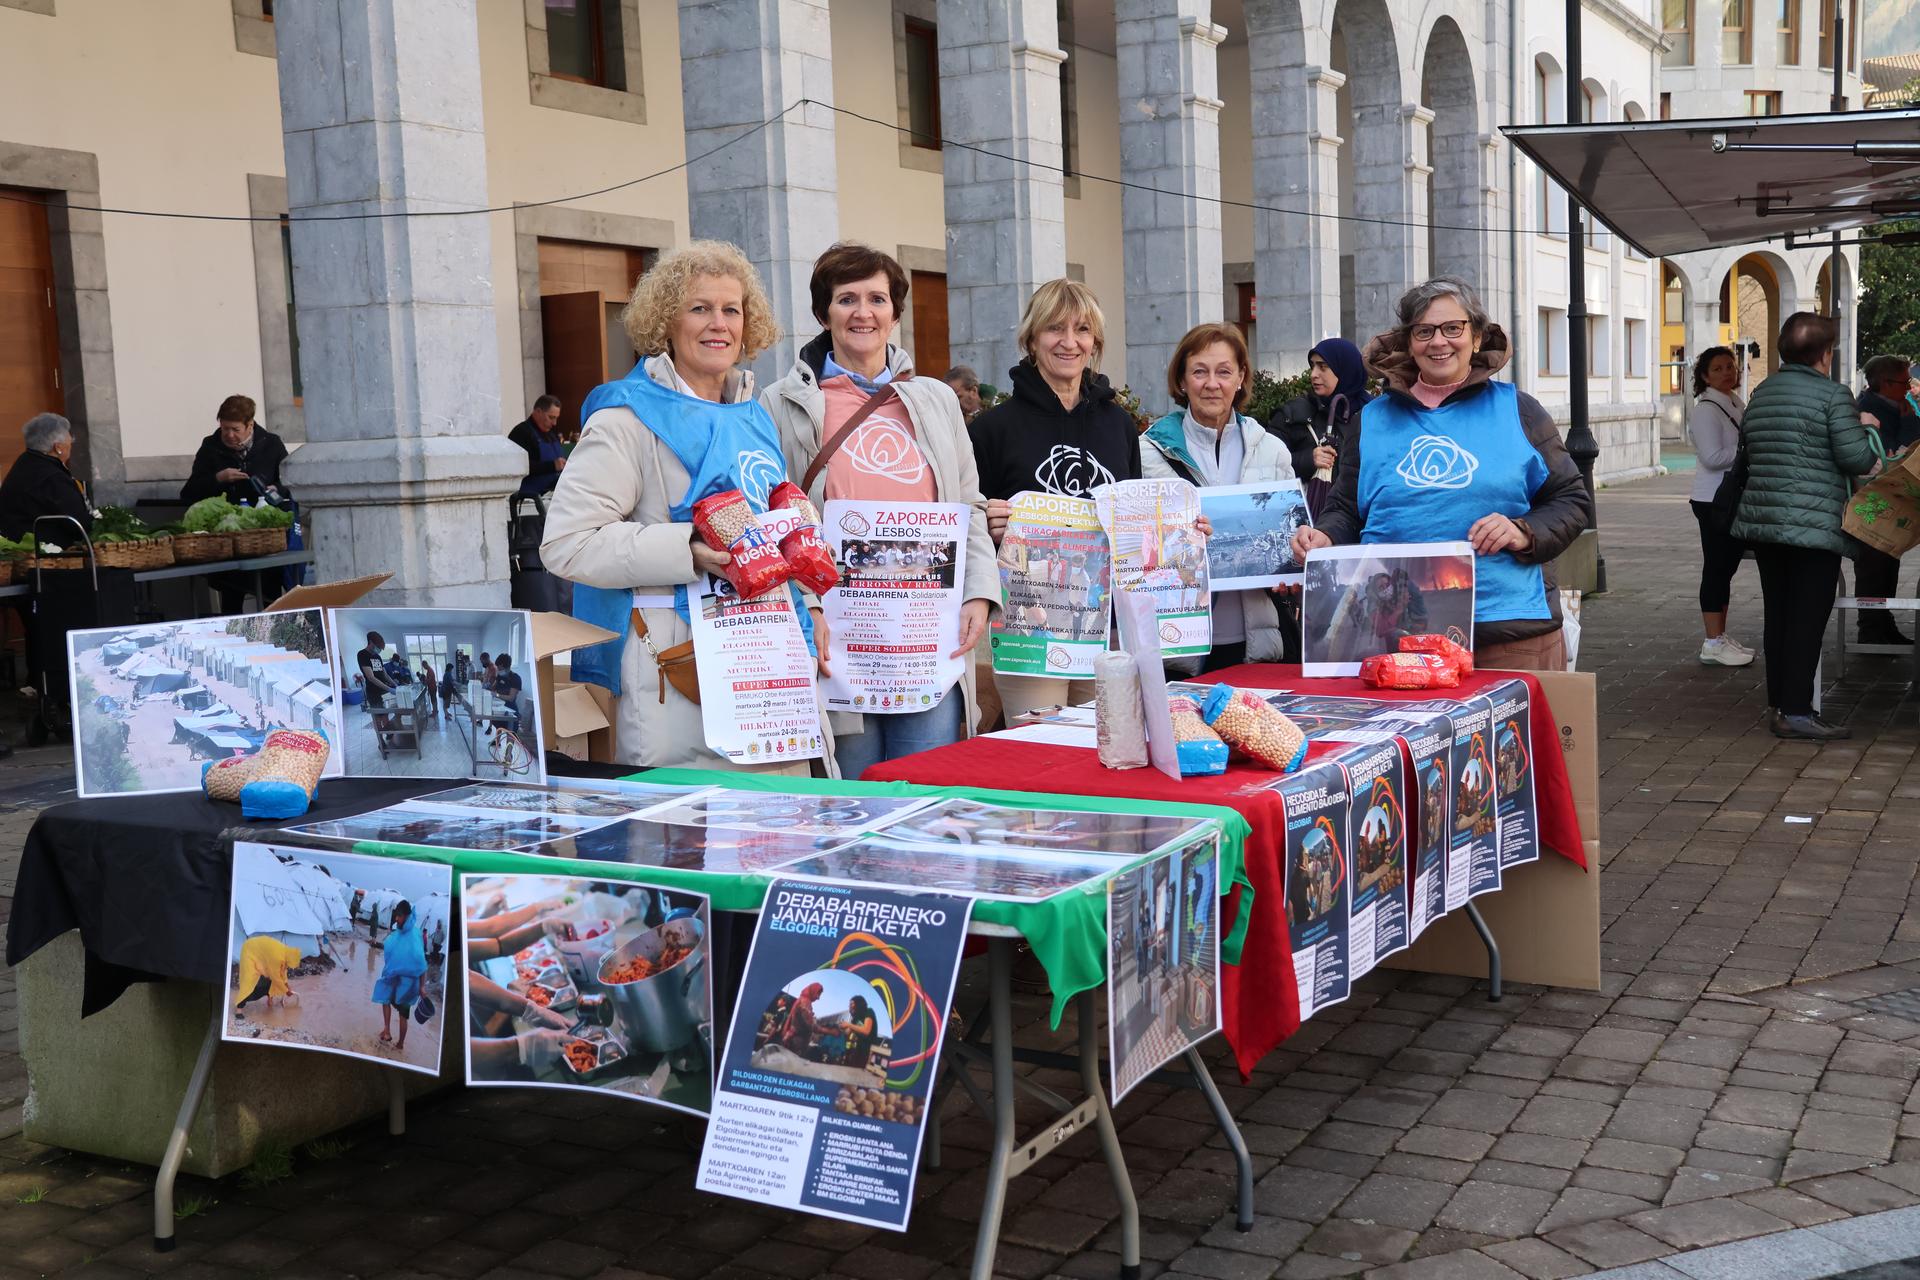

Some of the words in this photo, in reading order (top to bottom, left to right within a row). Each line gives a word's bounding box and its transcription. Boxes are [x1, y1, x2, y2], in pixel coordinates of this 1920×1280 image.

[876, 511, 958, 526] ZAPOREAK
[875, 527, 921, 537] LESBOS
[733, 542, 780, 568] lueng
[1011, 579, 1055, 589] MARTXOAREN
[840, 590, 909, 599] DEBABARRENA
[714, 615, 788, 629] DEBABARRENA
[883, 645, 936, 653] SOLIDARIOA
[734, 680, 769, 690] TUPER
[740, 722, 778, 731] BILKETA
[1350, 746, 1397, 778] DEBABARRENEKO
[1286, 790, 1319, 807] RECOGIDA
[1319, 787, 1328, 799] DE
[1288, 800, 1319, 818] ALIMENTO
[1319, 796, 1333, 811] BAJO
[1332, 791, 1346, 806] DEBA
[776, 891, 946, 927] DEBABARRENEKO
[769, 919, 838, 938] ELGOIBAR
[772, 906, 839, 929] JANARI
[843, 915, 921, 940] BILKETA
[732, 1069, 762, 1081] BILDUKO
[763, 1075, 778, 1084] DEN
[778, 1078, 815, 1091] ELIKAGAIA
[730, 1080, 772, 1094] GARBANTZU
[772, 1087, 830, 1104] PEDROSILLANOA
[719, 1100, 775, 1117] MARTXOAREN
[717, 1116, 744, 1127] Aurten
[744, 1120, 775, 1133] elikagai
[776, 1126, 803, 1138] bilketa
[821, 1116, 851, 1127] BILKETA
[715, 1124, 757, 1138] Elgoibarko
[713, 1135, 769, 1150] supermerkatu
[769, 1145, 783, 1153] eta
[829, 1132, 856, 1143] EROSKI
[856, 1137, 879, 1147] SANTA
[879, 1141, 894, 1150] ANA
[712, 1142, 750, 1155] dendetan
[750, 1149, 778, 1161] egingo
[779, 1155, 790, 1163] da
[708, 1159, 764, 1176] MARTXOAREN
[767, 1169, 786, 1180] 12an
[822, 1161, 847, 1172] KLARA
[824, 1153, 885, 1171] SUPERMERKATUA
[886, 1166, 909, 1176] SANTA
[704, 1178, 732, 1189] postua
[818, 1182, 845, 1193] EROSKI
[845, 1187, 874, 1199] CENTER
[829, 1193, 865, 1206] ELGOIBAR
